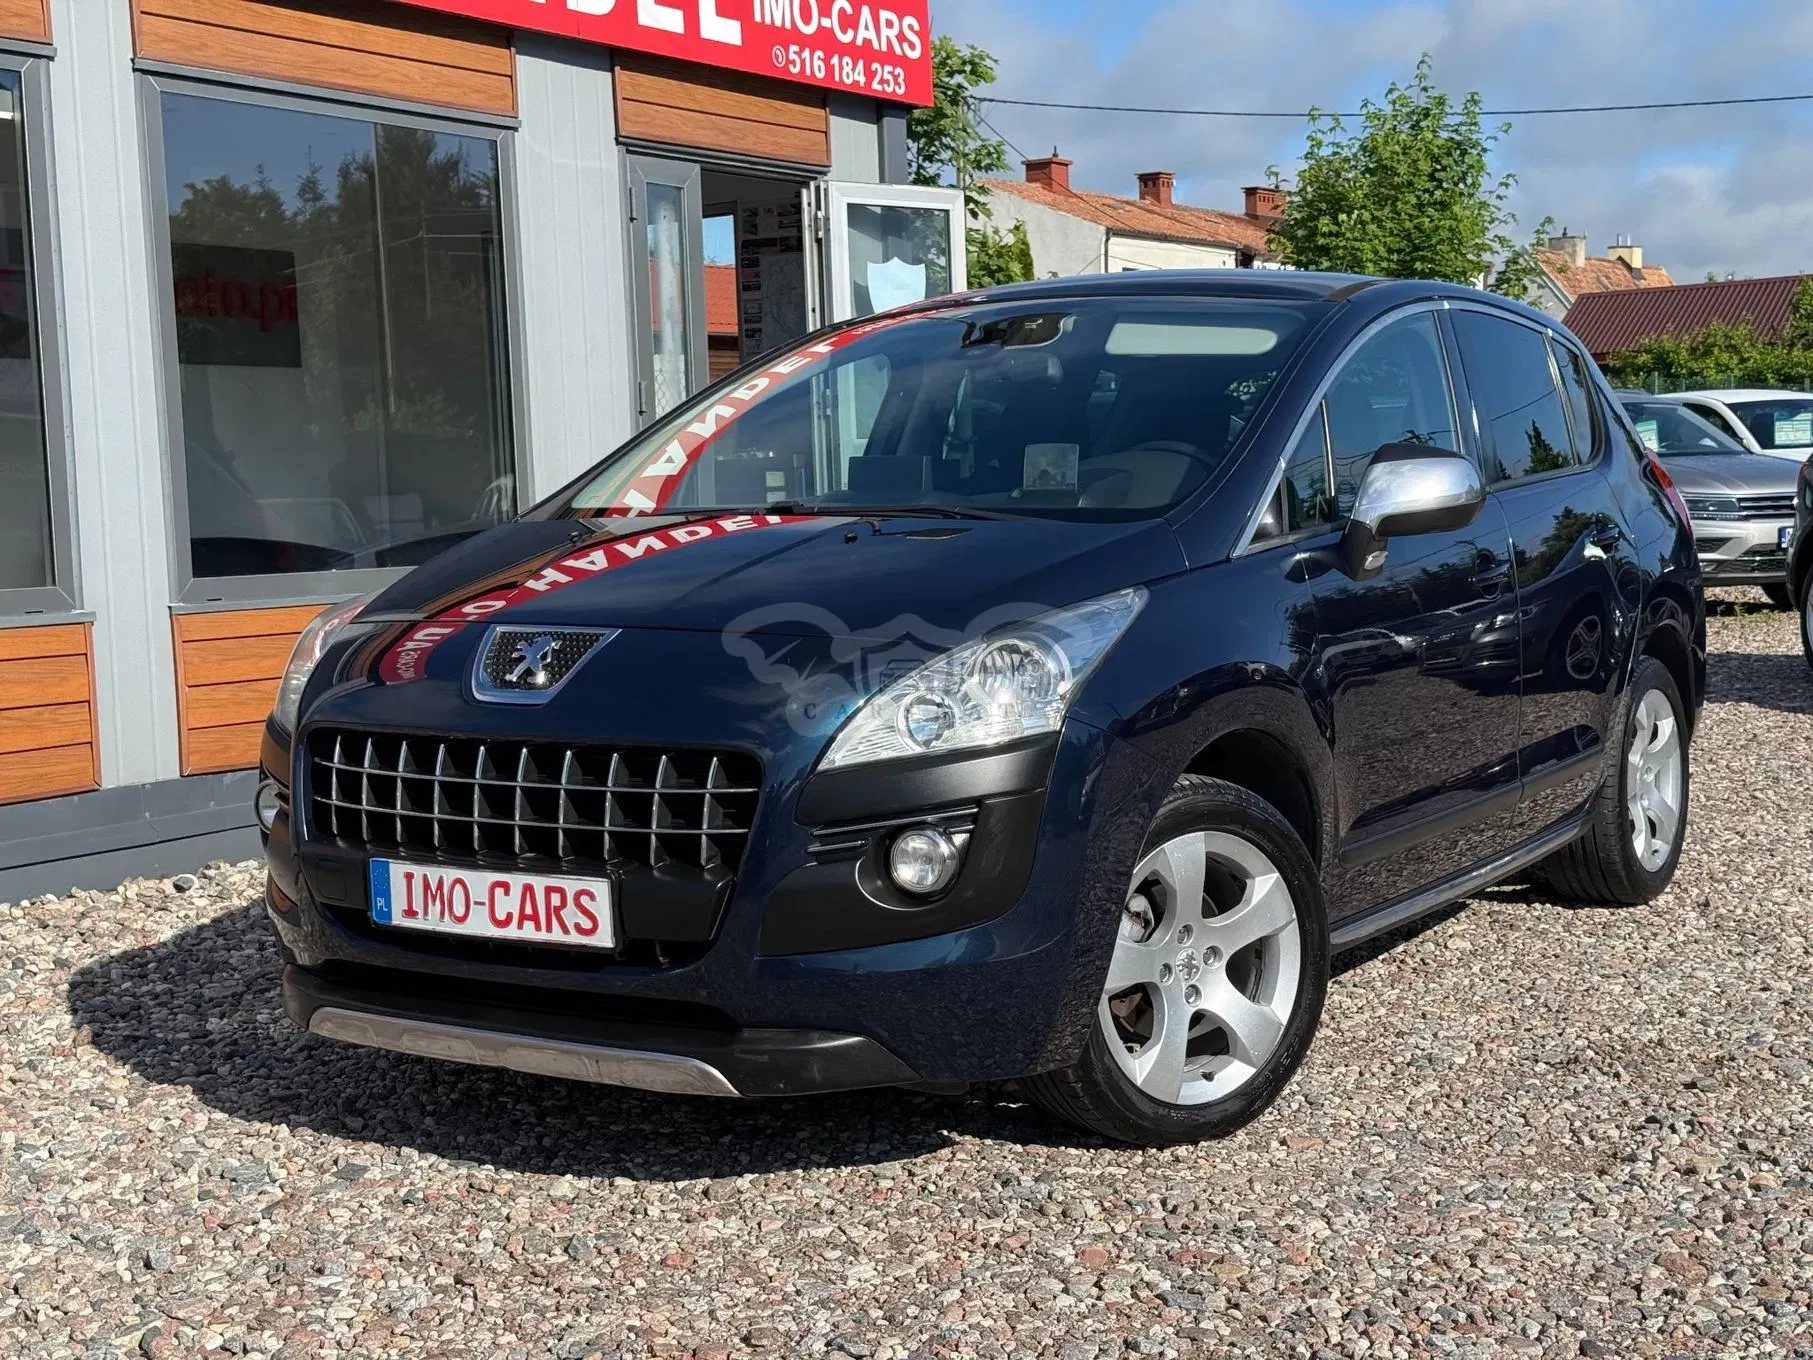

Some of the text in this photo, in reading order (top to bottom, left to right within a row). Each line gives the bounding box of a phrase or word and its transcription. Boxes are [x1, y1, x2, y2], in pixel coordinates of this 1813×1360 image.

[753, 0, 922, 60] IMO-CARS
[788, 44, 906, 95] 516 184 253
[377, 897, 388, 912] PL
[402, 871, 600, 936] IMO-CARS
